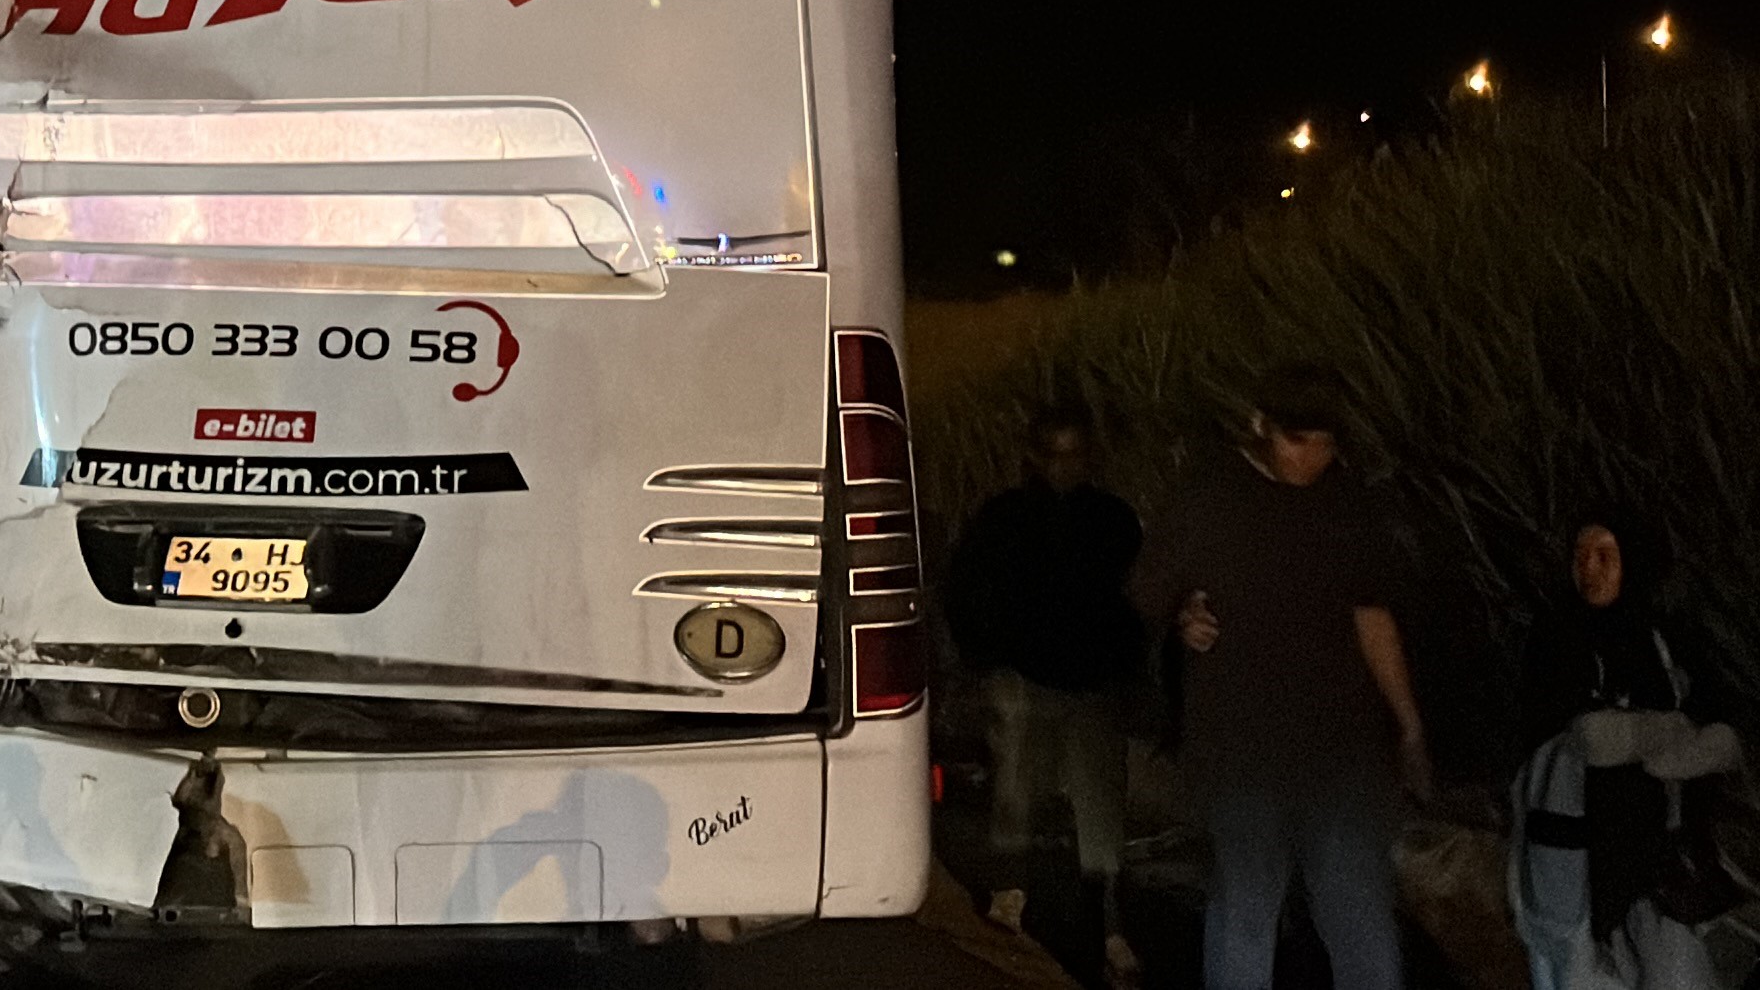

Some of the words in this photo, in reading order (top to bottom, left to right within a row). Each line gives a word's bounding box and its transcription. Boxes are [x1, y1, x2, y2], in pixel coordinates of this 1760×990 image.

[69, 322, 194, 356] 0850
[211, 323, 299, 357] 333
[318, 326, 390, 361] 00
[409, 329, 478, 364] 58
[203, 413, 307, 439] e-bilet
[71, 457, 468, 495] uzurturizm.com.tr
[174, 540, 212, 564] 34
[162, 584, 176, 595] TR
[211, 568, 292, 593] 9095
[715, 618, 745, 659] D
